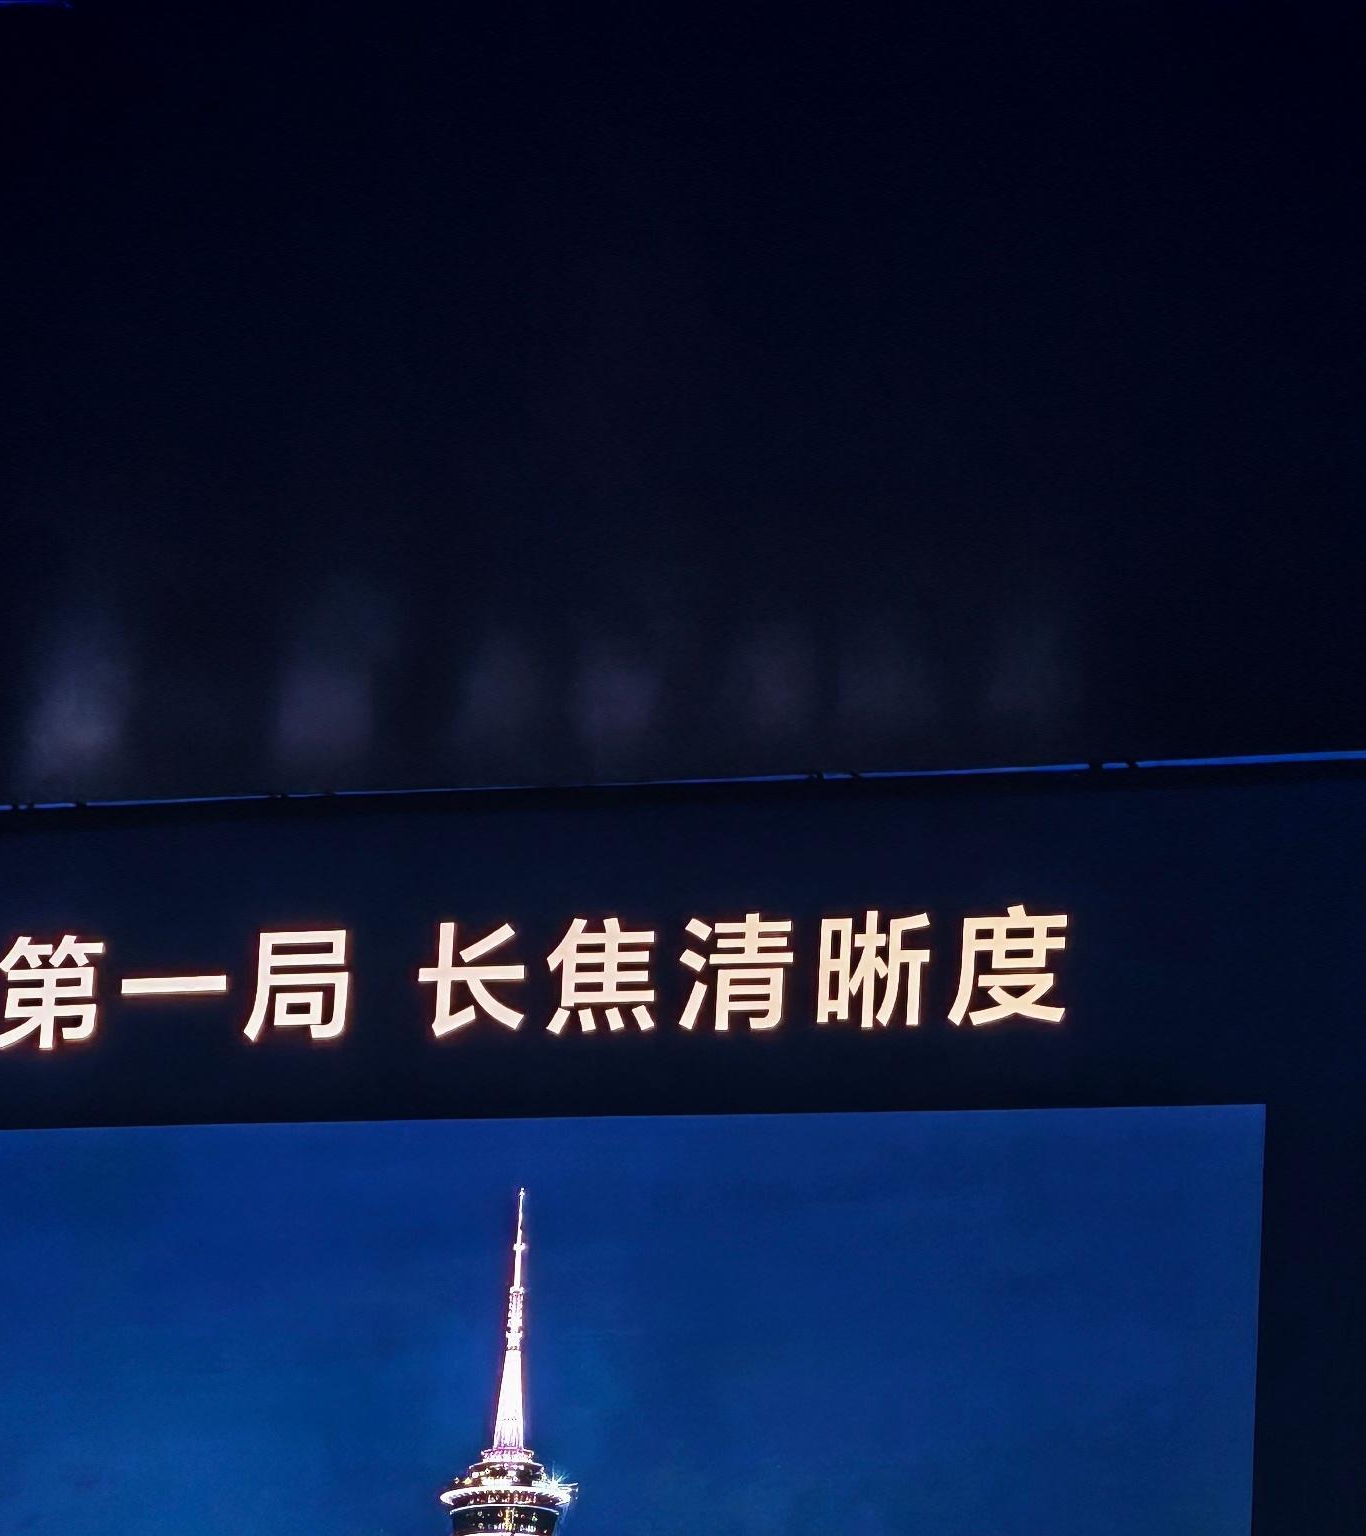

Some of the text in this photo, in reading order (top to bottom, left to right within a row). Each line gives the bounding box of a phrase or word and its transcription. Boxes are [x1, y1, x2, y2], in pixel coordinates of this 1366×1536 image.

[417, 904, 1069, 1039] 长焦清晰度
